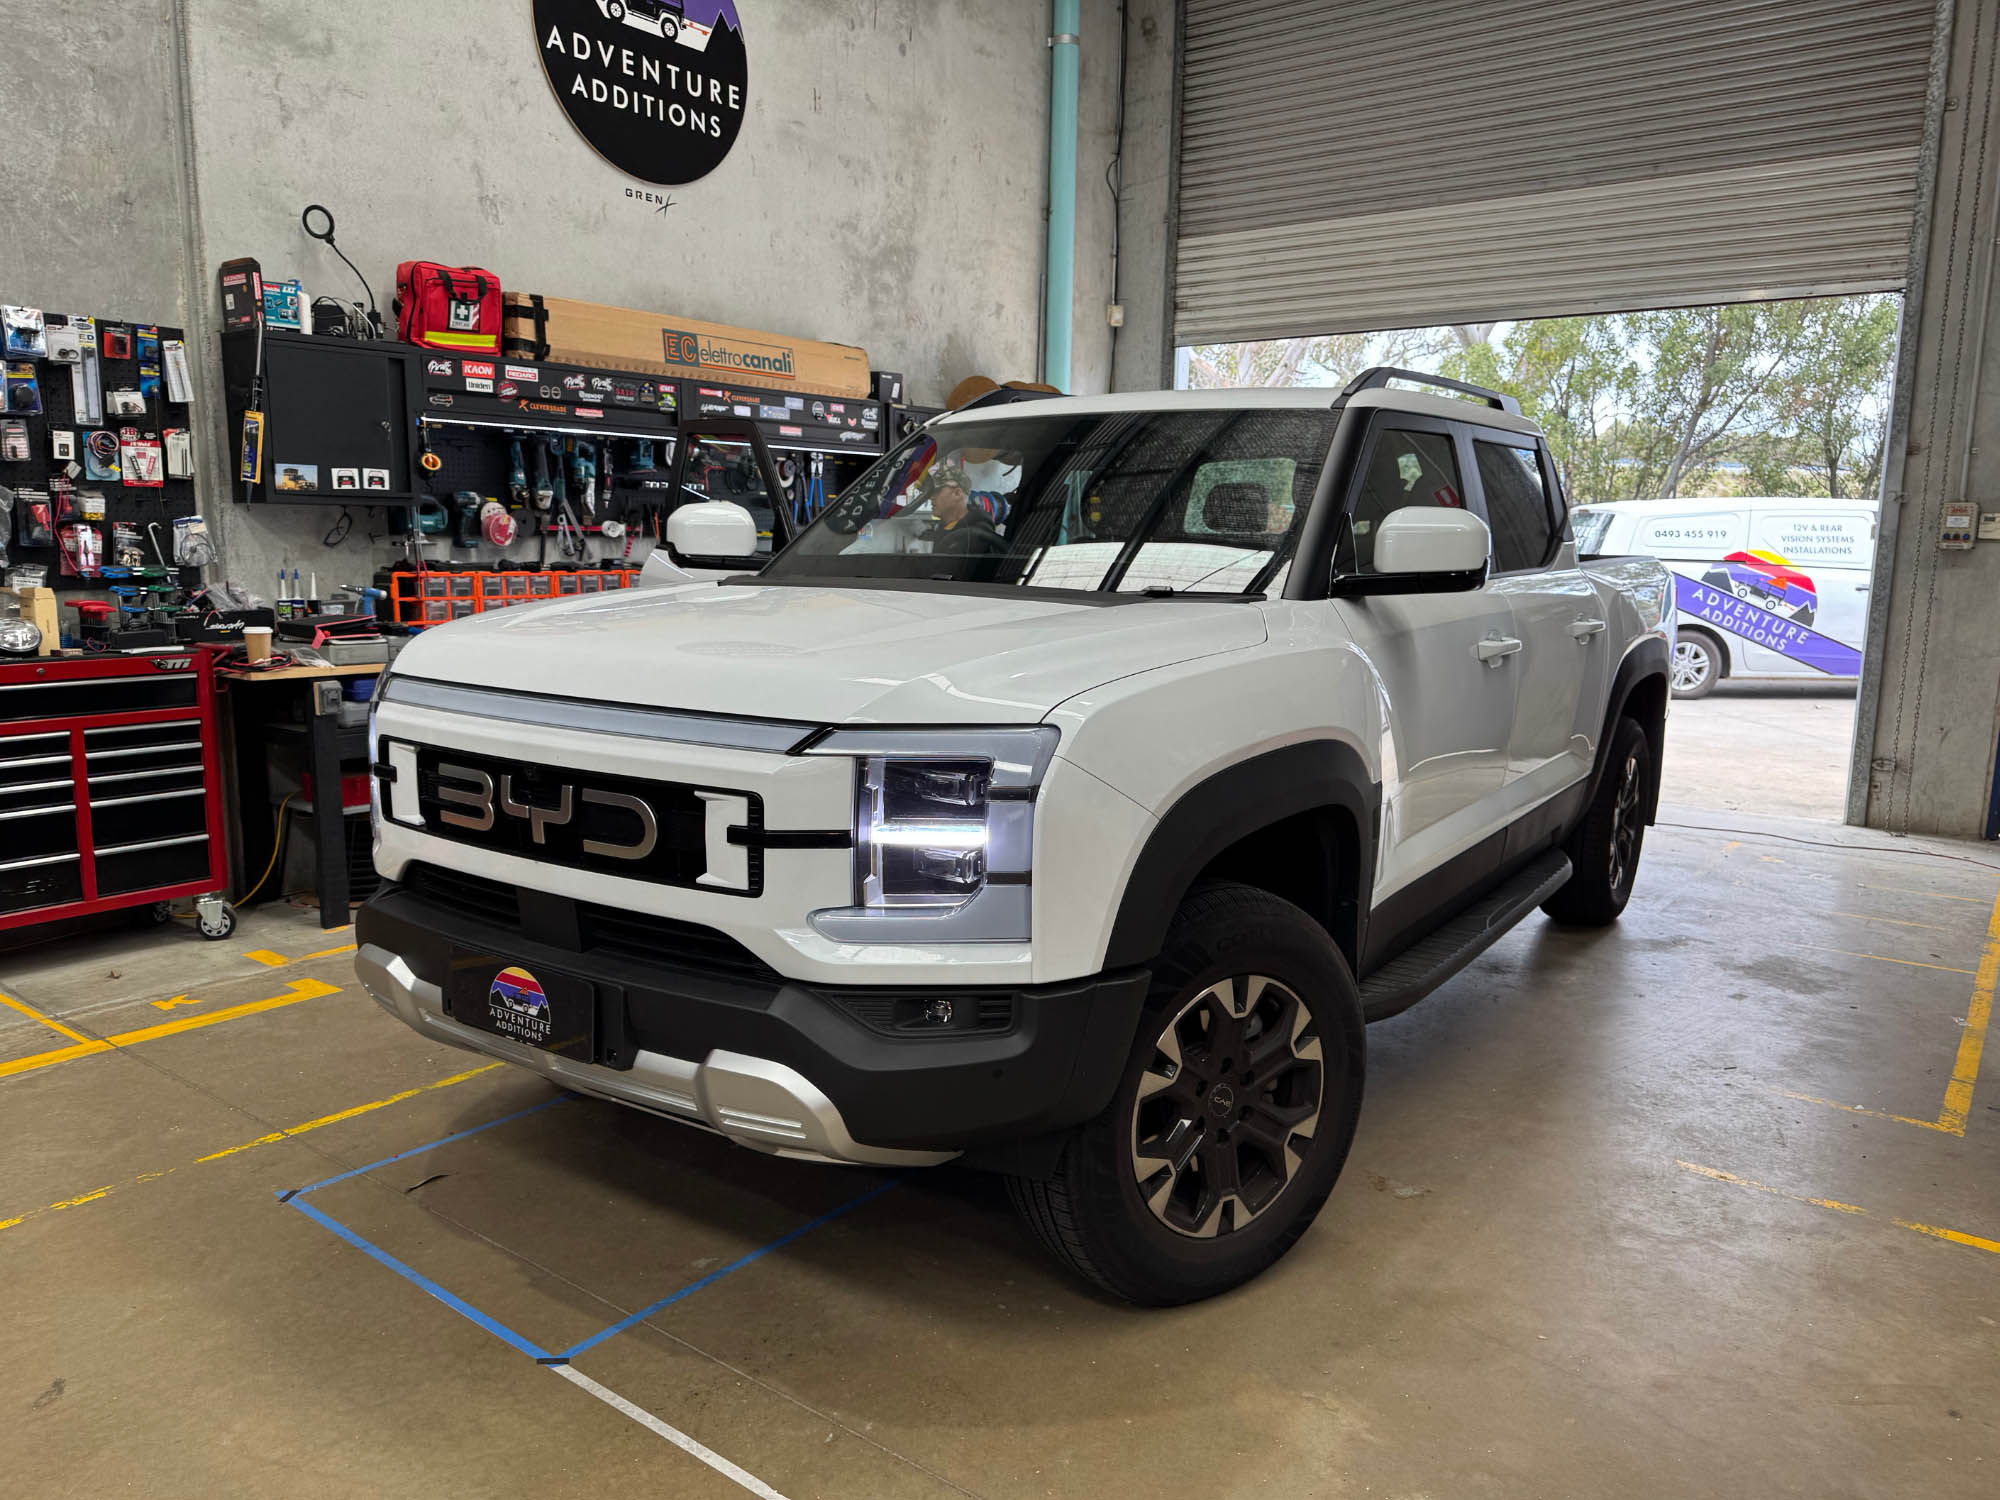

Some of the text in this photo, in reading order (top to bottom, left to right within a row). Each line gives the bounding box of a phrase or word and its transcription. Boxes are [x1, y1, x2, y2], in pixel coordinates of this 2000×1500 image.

[546, 25, 740, 110] ADVENTURE
[571, 73, 722, 138] ADDITIONS
[664, 332, 697, 363] EC
[700, 340, 792, 373] elettrocanali
[464, 364, 493, 376] KAON
[468, 381, 491, 390] Uniden
[1654, 530, 1727, 539] 0493 455 919
[1781, 535, 1855, 543] VISION SYSTEMS
[1793, 524, 1808, 532] 12V
[1820, 524, 1843, 532] REAR
[1783, 546, 1853, 554] INSTALLATIONS
[1692, 588, 1809, 646] ADVENTURE
[1701, 607, 1788, 652] ADDITIONS
[438, 762, 658, 860] BYD
[490, 1007, 551, 1035] ADVENTURE
[496, 1020, 543, 1042] ADDITIONS
